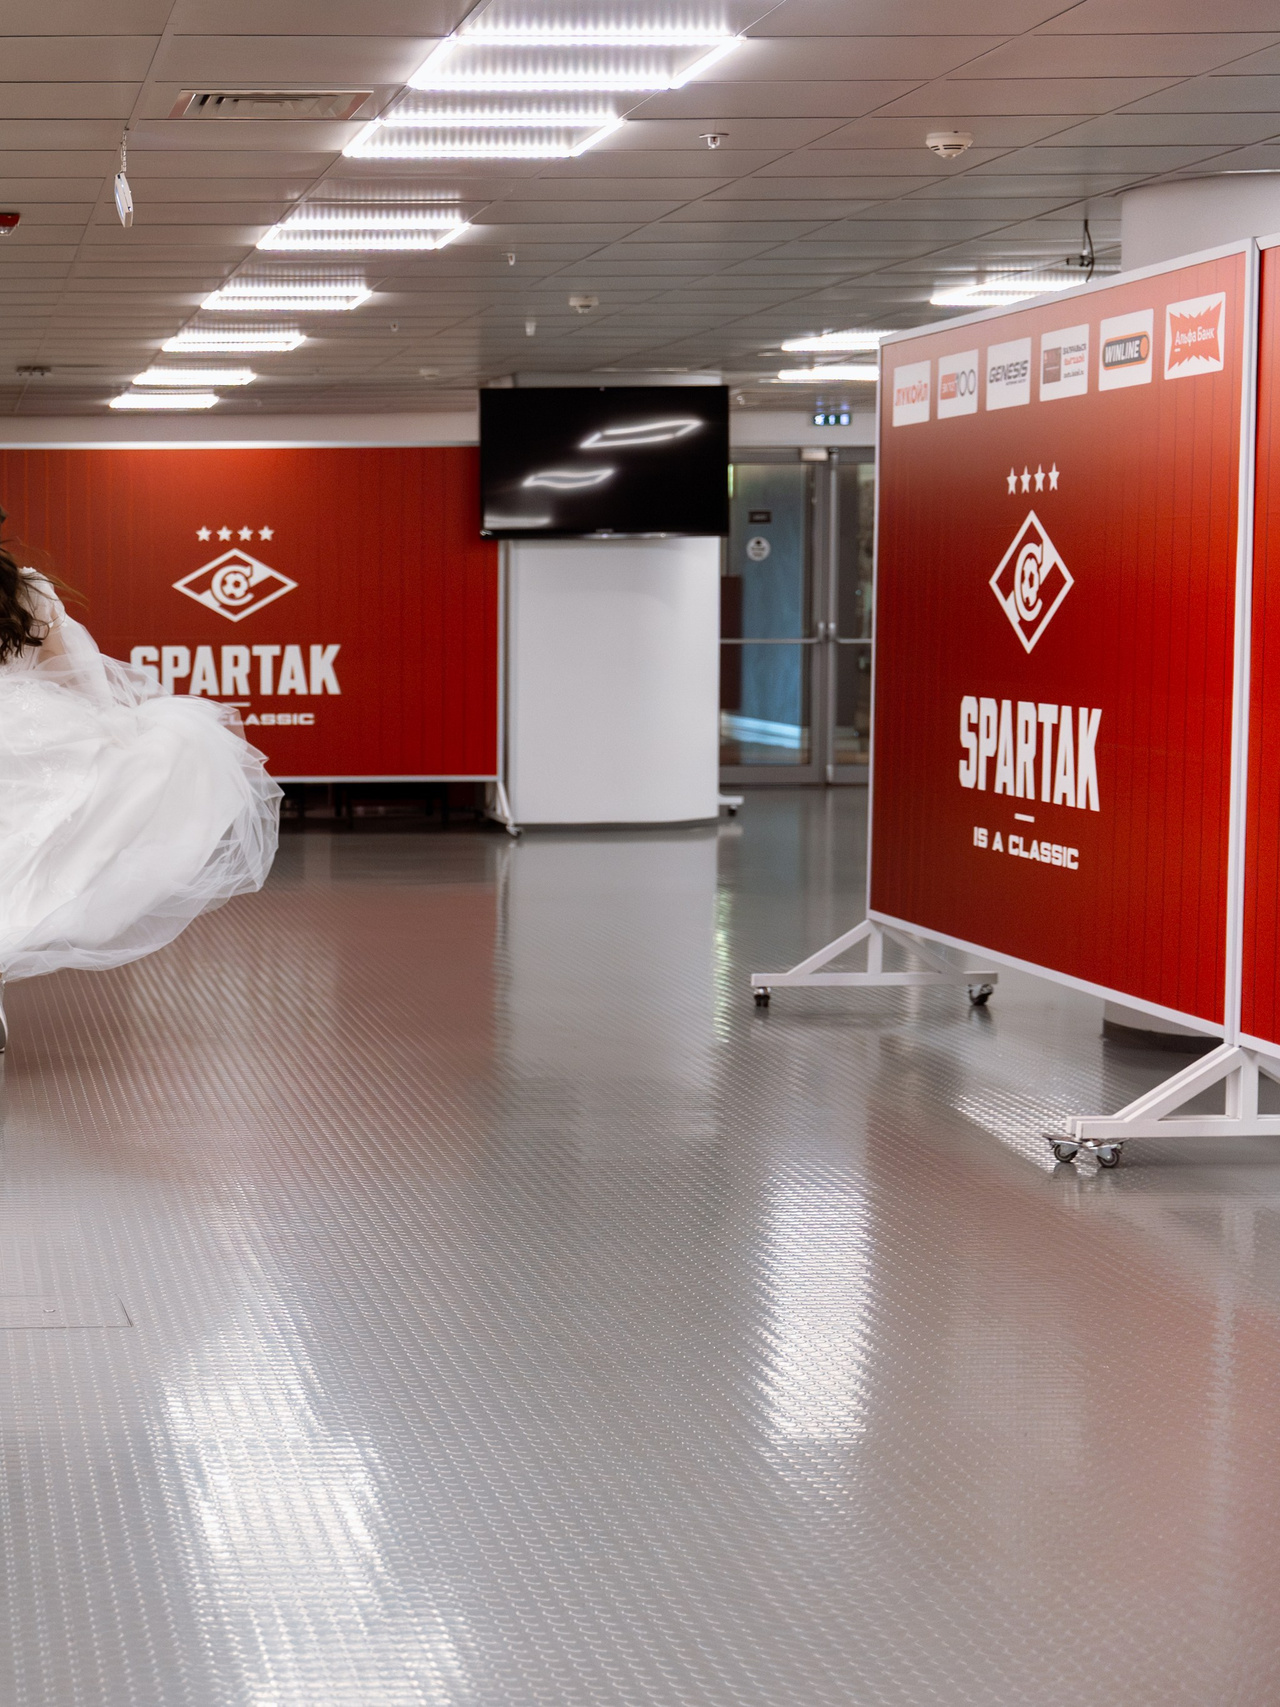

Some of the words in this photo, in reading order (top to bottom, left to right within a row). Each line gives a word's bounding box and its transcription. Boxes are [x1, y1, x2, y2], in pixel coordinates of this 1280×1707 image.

[1105, 340, 1140, 363] WINLINE
[1174, 329, 1196, 346] Альфа
[1197, 326, 1215, 341] Банк
[989, 360, 1028, 383] GENESIS
[130, 644, 341, 696] SPARTAK
[958, 695, 1102, 812] SPARTAK
[972, 826, 988, 848] IS
[992, 831, 1004, 852] A
[1008, 834, 1079, 870] CLASSIC
